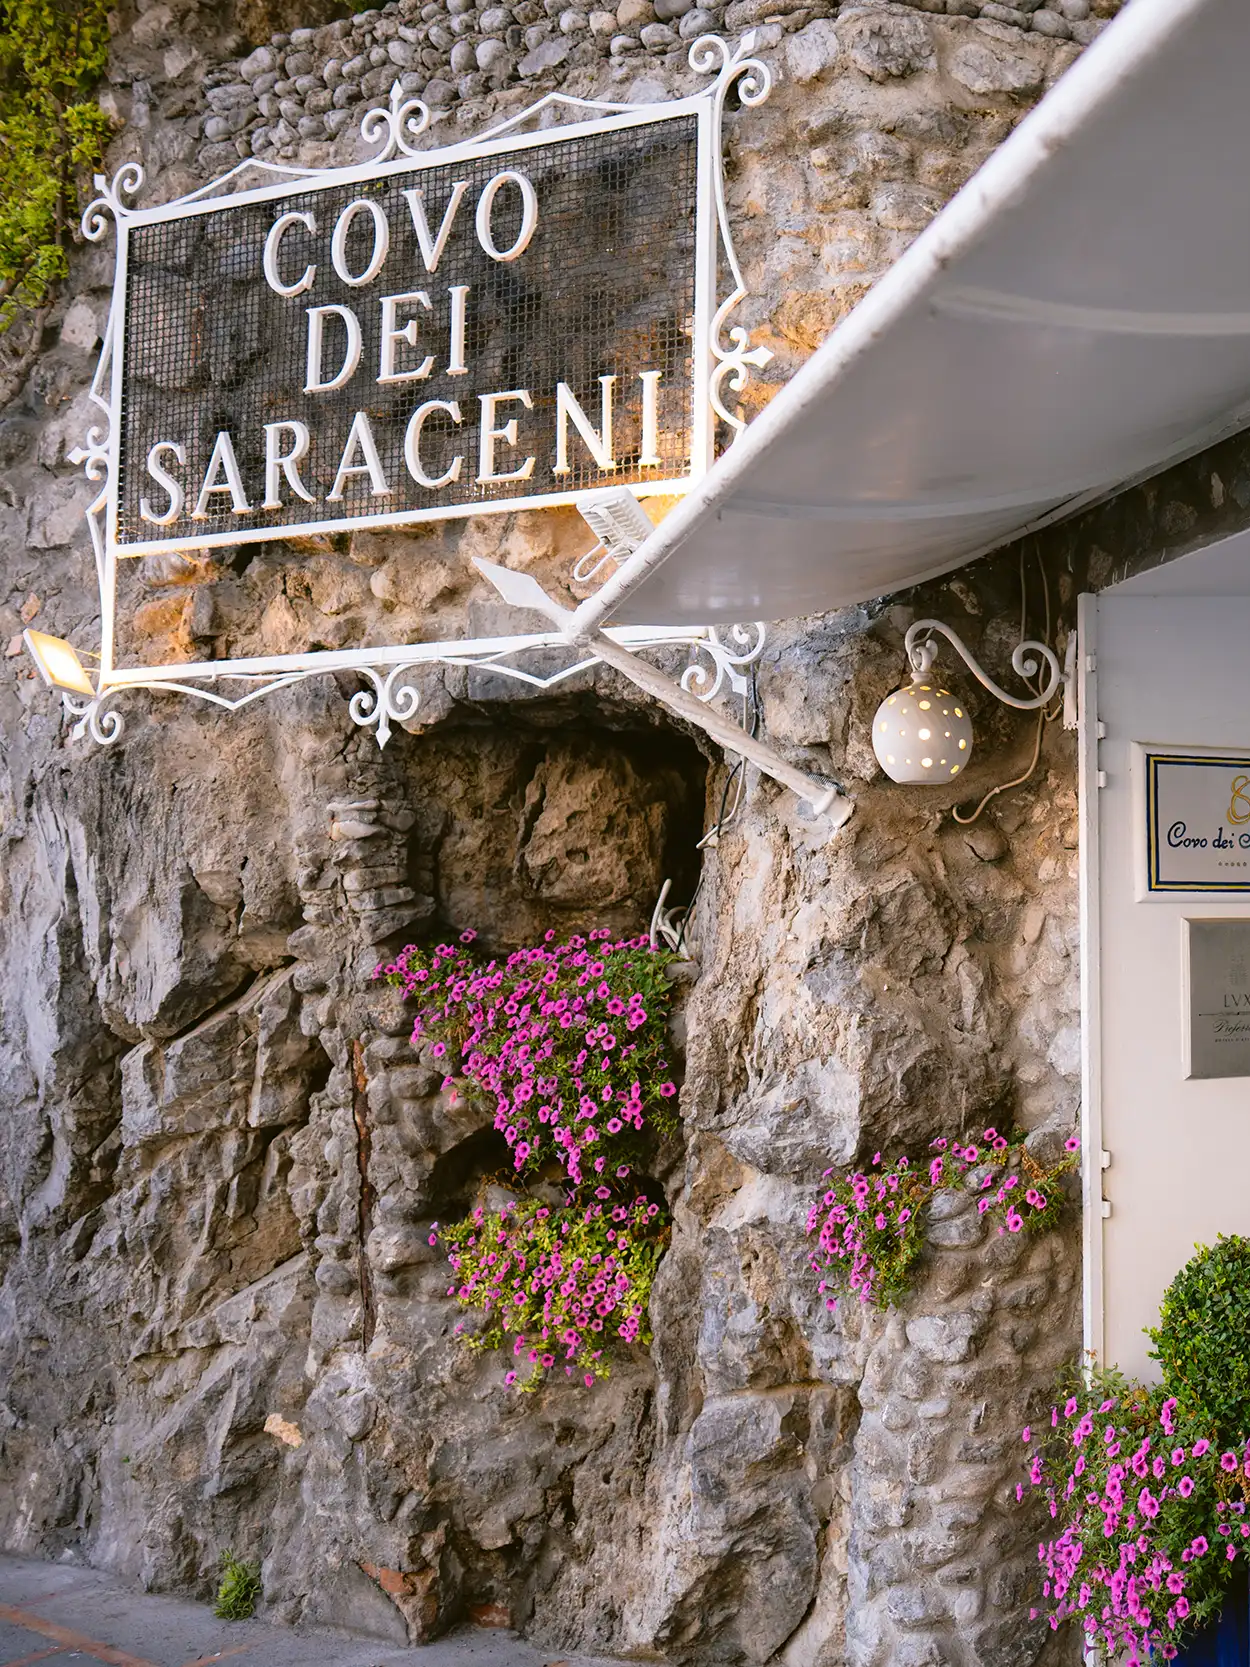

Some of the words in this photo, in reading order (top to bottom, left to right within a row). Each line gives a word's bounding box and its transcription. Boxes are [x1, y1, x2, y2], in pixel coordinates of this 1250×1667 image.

[263, 171, 538, 298] COVO
[303, 285, 471, 395] DEI
[139, 370, 662, 526] SARACENI
[1167, 821, 1208, 848] Covo
[1212, 827, 1234, 849] dei
